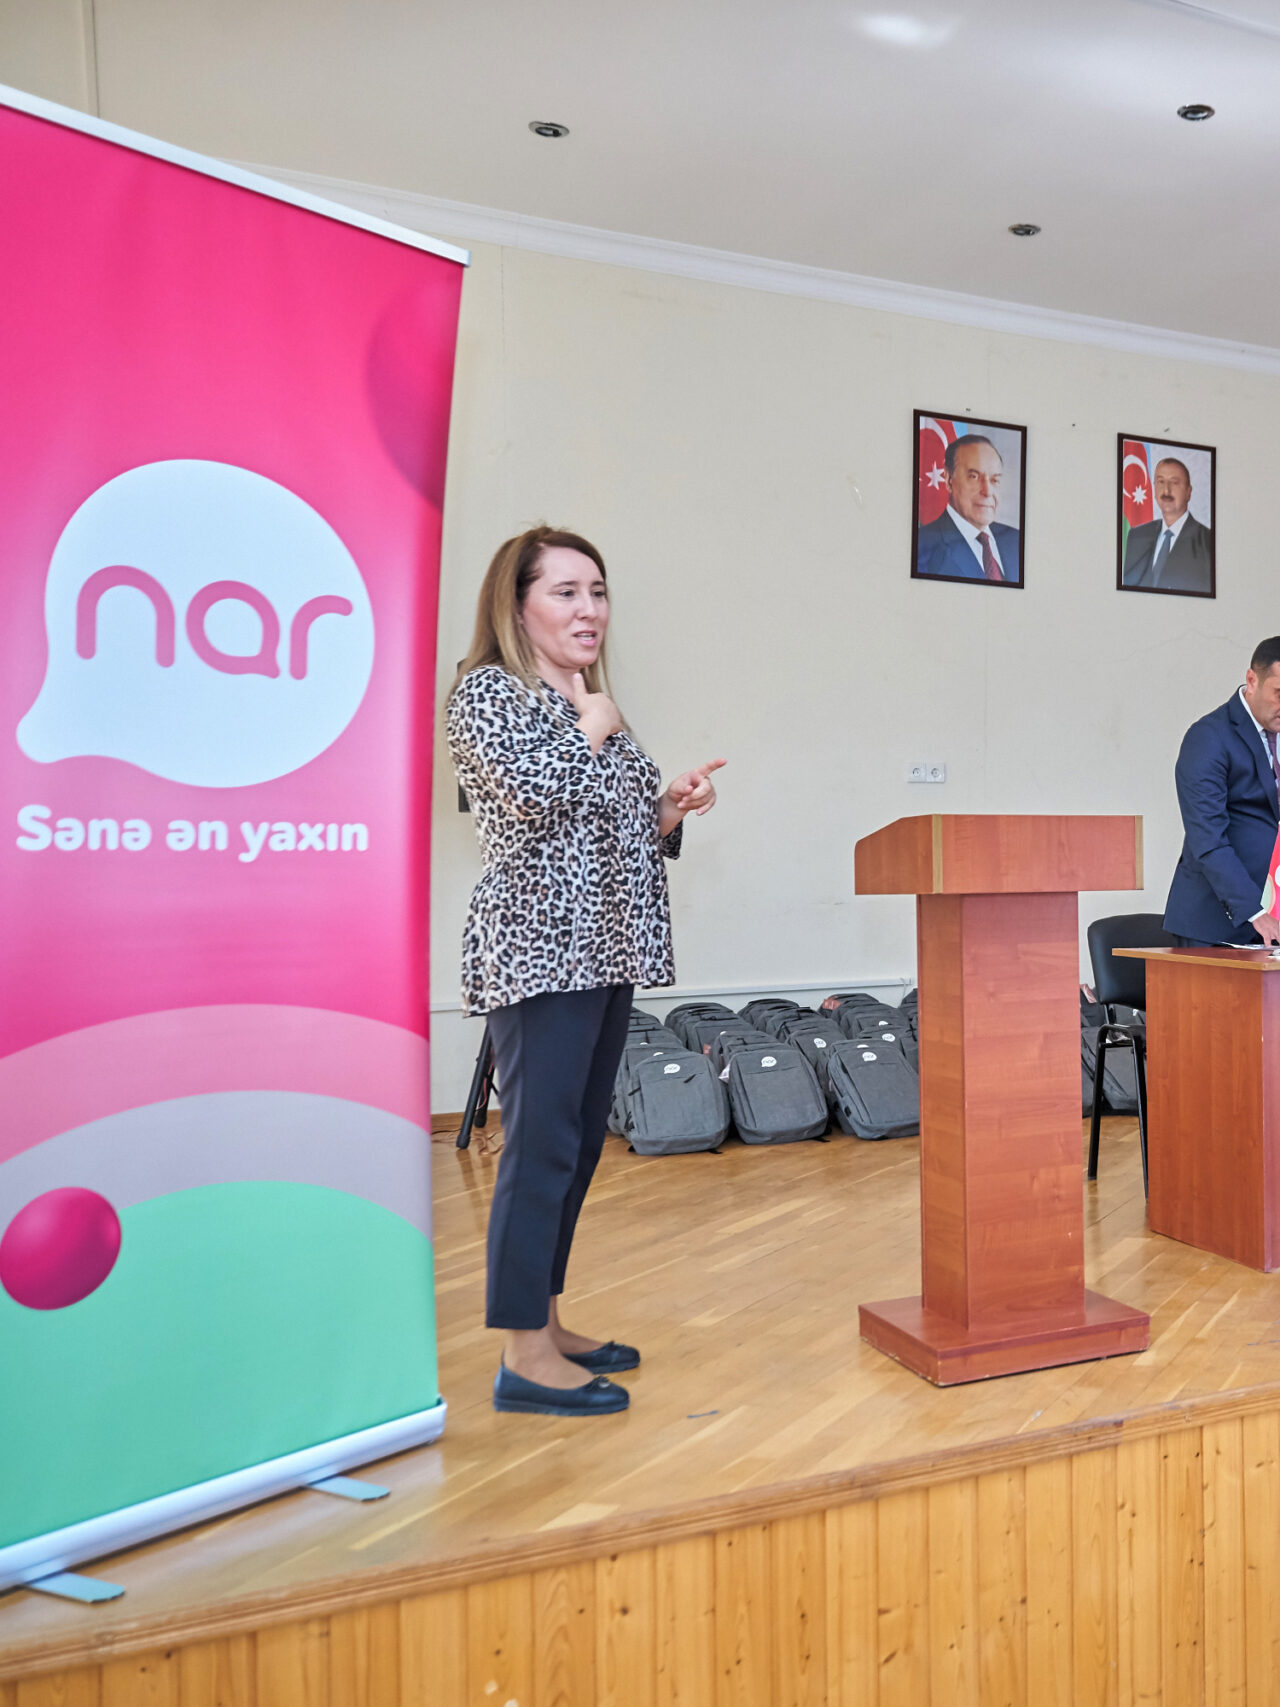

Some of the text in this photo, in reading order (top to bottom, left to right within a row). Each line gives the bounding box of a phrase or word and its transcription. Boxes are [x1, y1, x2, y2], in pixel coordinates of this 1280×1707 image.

[75, 565, 354, 681] nar
[16, 804, 369, 863] Sənə ən yaxın
